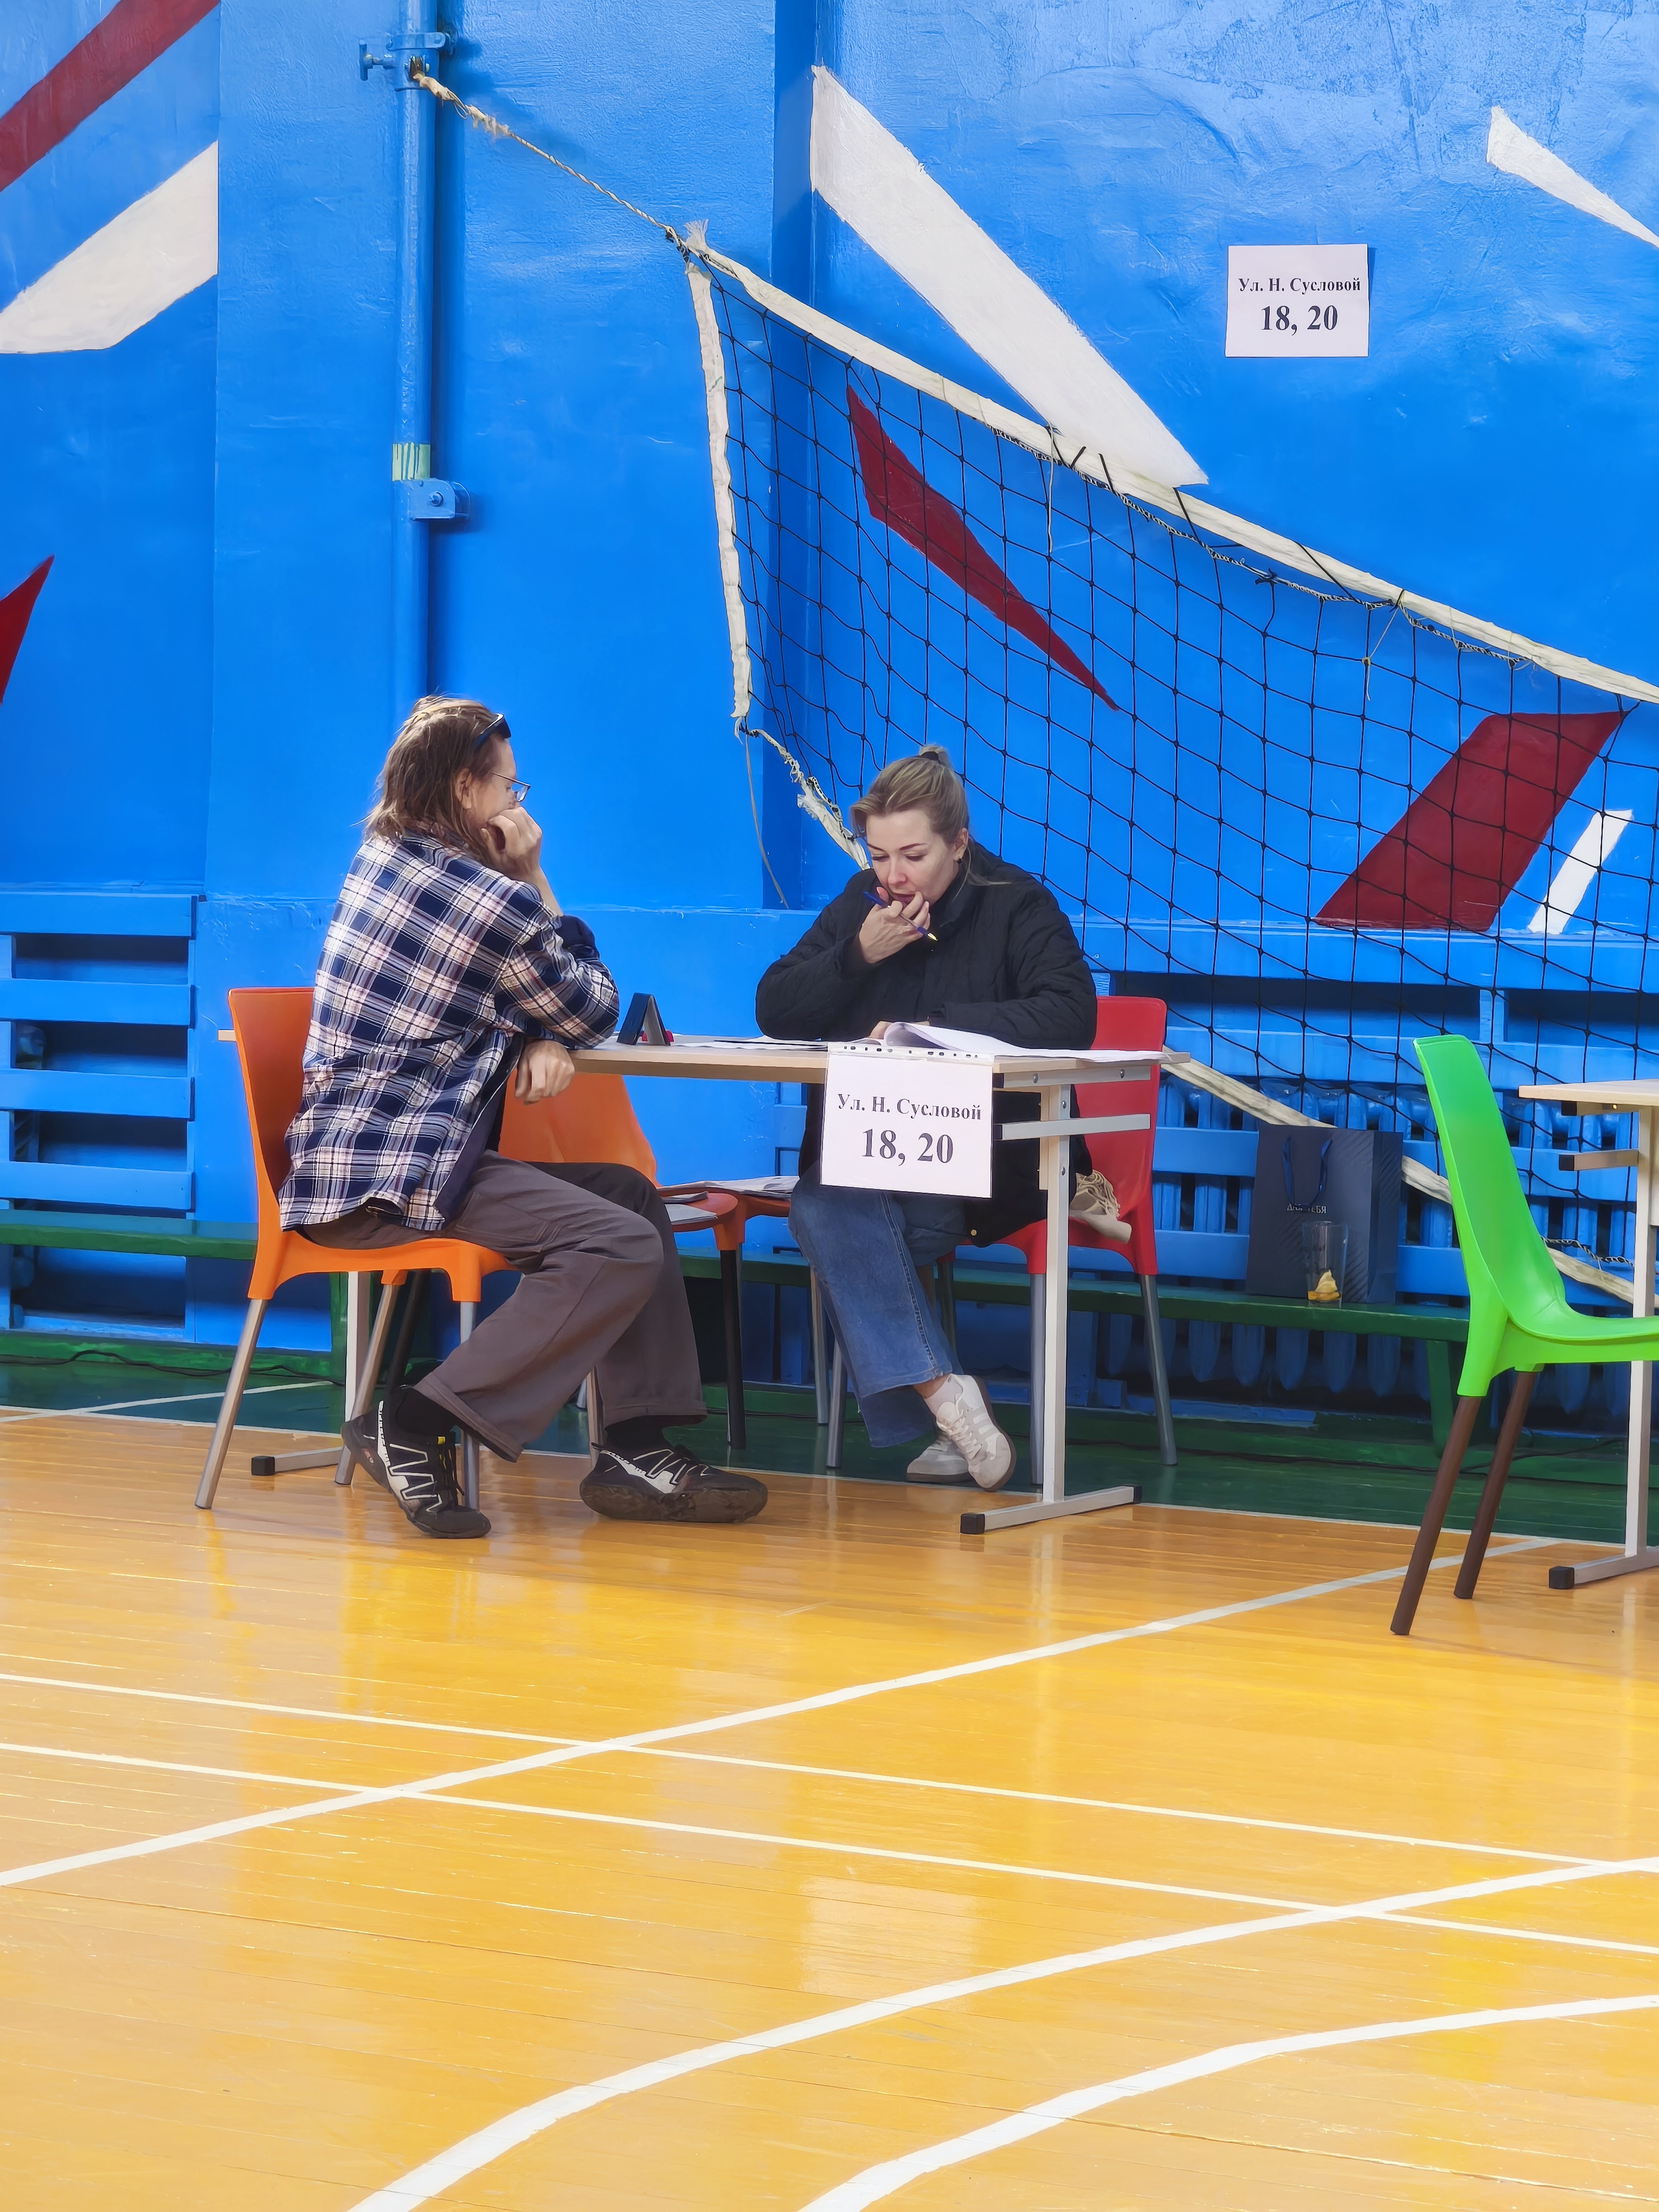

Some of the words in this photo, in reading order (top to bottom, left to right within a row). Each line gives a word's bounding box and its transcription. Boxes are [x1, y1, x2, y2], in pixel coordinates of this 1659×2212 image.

[1238, 278, 1263, 292] Ул.
[1268, 278, 1284, 292] Н.
[1290, 277, 1361, 295] Сусловой
[1261, 305, 1297, 336] 18,
[1307, 305, 1338, 331] 20
[838, 1094, 865, 1111] Ул.
[872, 1096, 890, 1113] Н.
[897, 1098, 981, 1120] Сусловой
[861, 1128, 905, 1167] 18,
[917, 1133, 954, 1163] 20
